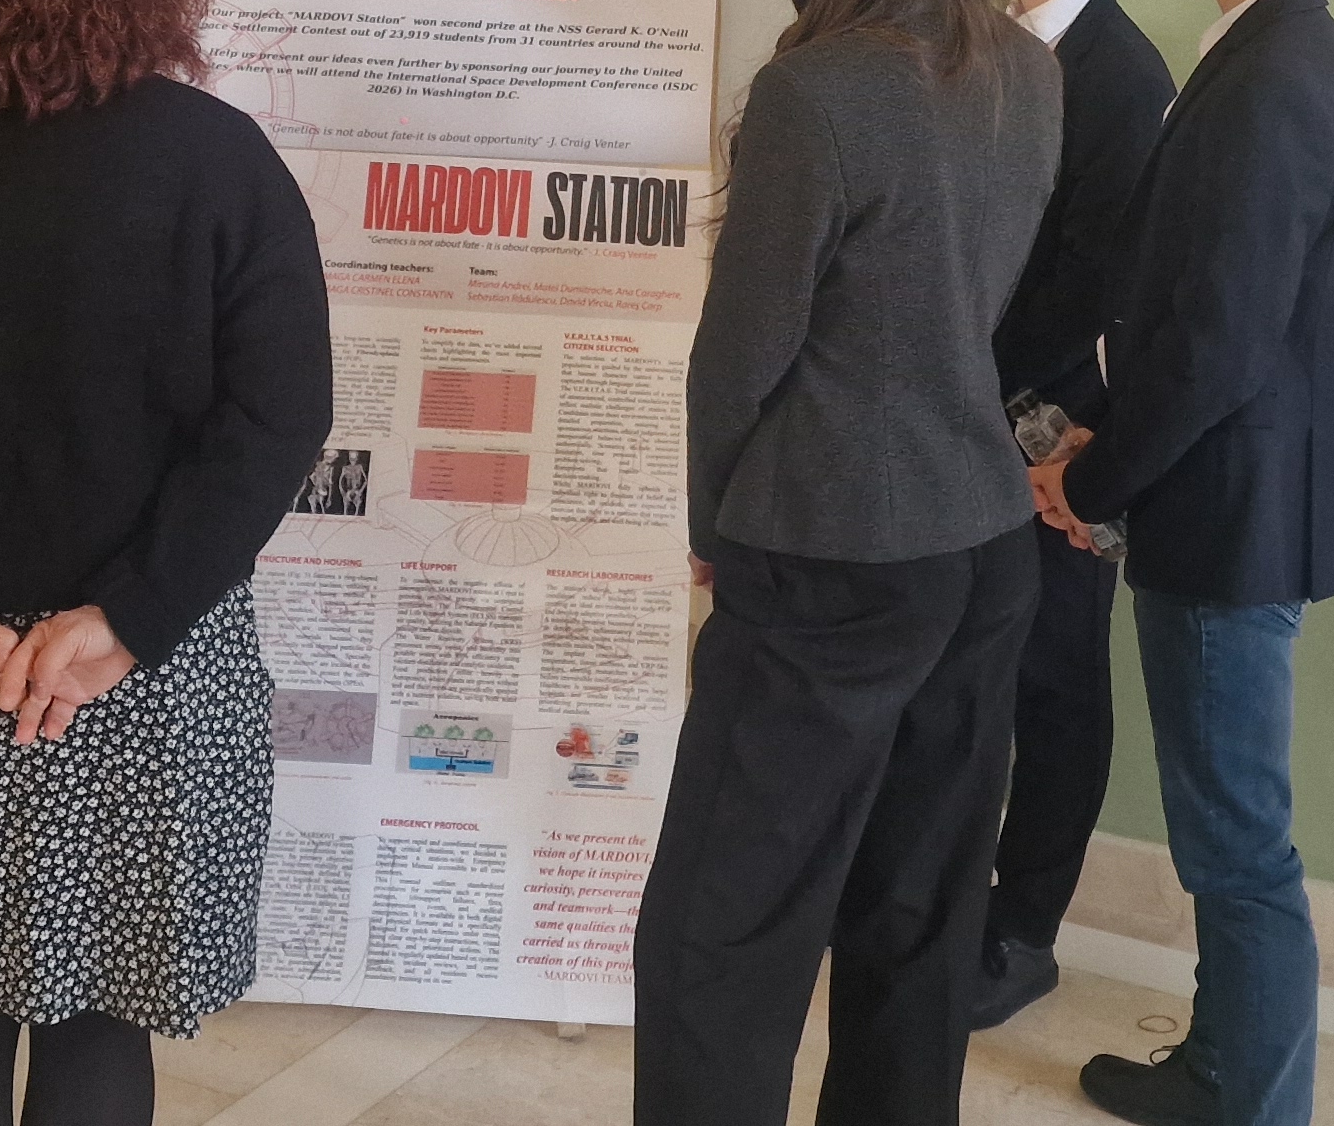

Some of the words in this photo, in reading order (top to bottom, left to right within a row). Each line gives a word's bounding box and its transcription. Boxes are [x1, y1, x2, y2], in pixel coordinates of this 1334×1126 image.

[211, 7, 233, 18] Our
[238, 8, 283, 22] project:
[288, 10, 354, 24] “MARDOVI
[357, 13, 406, 26] Station”
[414, 18, 436, 27] won
[440, 17, 482, 29] second
[486, 19, 515, 33] prize
[519, 21, 531, 31] at
[535, 21, 554, 32] the
[558, 22, 582, 34] NSS
[586, 23, 627, 35] Gerard
[631, 25, 642, 36] K.
[647, 26, 688, 38] O'Neill
[232, 21, 298, 34] Settlement
[301, 24, 347, 37] Contest
[351, 27, 370, 38] out
[374, 28, 387, 41] of
[389, 29, 431, 43] 23,919
[434, 31, 484, 44] students
[487, 34, 516, 47] from
[519, 35, 535, 46] 31
[539, 36, 594, 49] countries
[598, 38, 641, 51] around
[645, 40, 664, 52] the
[668, 41, 704, 53] world.
[208, 46, 238, 60] Help
[241, 50, 256, 59] us
[259, 49, 303, 64] present
[308, 54, 329, 63] our
[332, 53, 364, 65] ideas
[367, 57, 395, 66] even
[398, 56, 442, 71] further
[445, 58, 460, 71] by
[462, 59, 528, 74] sponsoring
[532, 64, 553, 73] our
[555, 63, 602, 77] journey
[604, 65, 616, 76] to
[620, 66, 639, 77] the
[643, 66, 684, 78] United
[236, 60, 274, 73] where
[277, 65, 293, 74] we
[296, 64, 319, 76] will
[321, 66, 361, 78] attend
[364, 68, 384, 80] the
[387, 69, 466, 84] International
[470, 74, 506, 87] Space
[509, 75, 587, 91] Development
[591, 78, 659, 91] Conference
[663, 81, 699, 94] (ISDC
[367, 84, 402, 97] 2026)
[405, 85, 417, 96] in
[422, 86, 492, 101] Washington
[496, 89, 520, 100] D.C.
[268, 123, 321, 136] “Genetics
[336, 127, 354, 138] not
[357, 128, 388, 140] about
[439, 132, 471, 144] about
[560, 138, 591, 151] Craig
[595, 139, 632, 151] Venter
[364, 162, 532, 238] MARDOVI
[543, 171, 688, 247] STATION
[324, 259, 388, 273] Coordinating
[390, 263, 434, 273] teachers:
[469, 266, 498, 277] Team:
[440, 327, 484, 336] Parameters
[563, 343, 595, 352] CITIZEN
[596, 344, 640, 353] SELECTION
[255, 555, 302, 565] TRUCTURE
[303, 556, 322, 566] AND
[324, 558, 362, 568] HOUSING
[400, 561, 417, 571] LIFE
[419, 563, 458, 572] SUPPORT
[546, 569, 589, 579] RESEARCH
[591, 571, 654, 582] LABORATORIES
[380, 818, 431, 829] EMERGENCY
[433, 820, 480, 832] PROTOCOL
[542, 830, 561, 841] “As
[565, 834, 581, 842] we
[582, 835, 625, 846] present
[628, 836, 647, 846] the
[532, 847, 565, 859] vision
[569, 849, 583, 861] of
[584, 850, 653, 865] MARDOVI,
[539, 867, 554, 876] we
[557, 866, 585, 880] hope
[588, 868, 597, 878] it
[599, 869, 644, 883] inspires
[523, 883, 575, 896] curiosity,
[577, 888, 642, 899] perseveran
[533, 901, 555, 912] and
[534, 920, 564, 930] same
[566, 921, 616, 934] qualities
[522, 937, 564, 948] carried
[567, 941, 580, 949] us
[583, 940, 631, 954] through
[516, 954, 563, 966] creation
[567, 956, 581, 969] of
[582, 957, 603, 968] this
[543, 971, 598, 983] MARDOVI
[602, 973, 633, 985] TEAM
